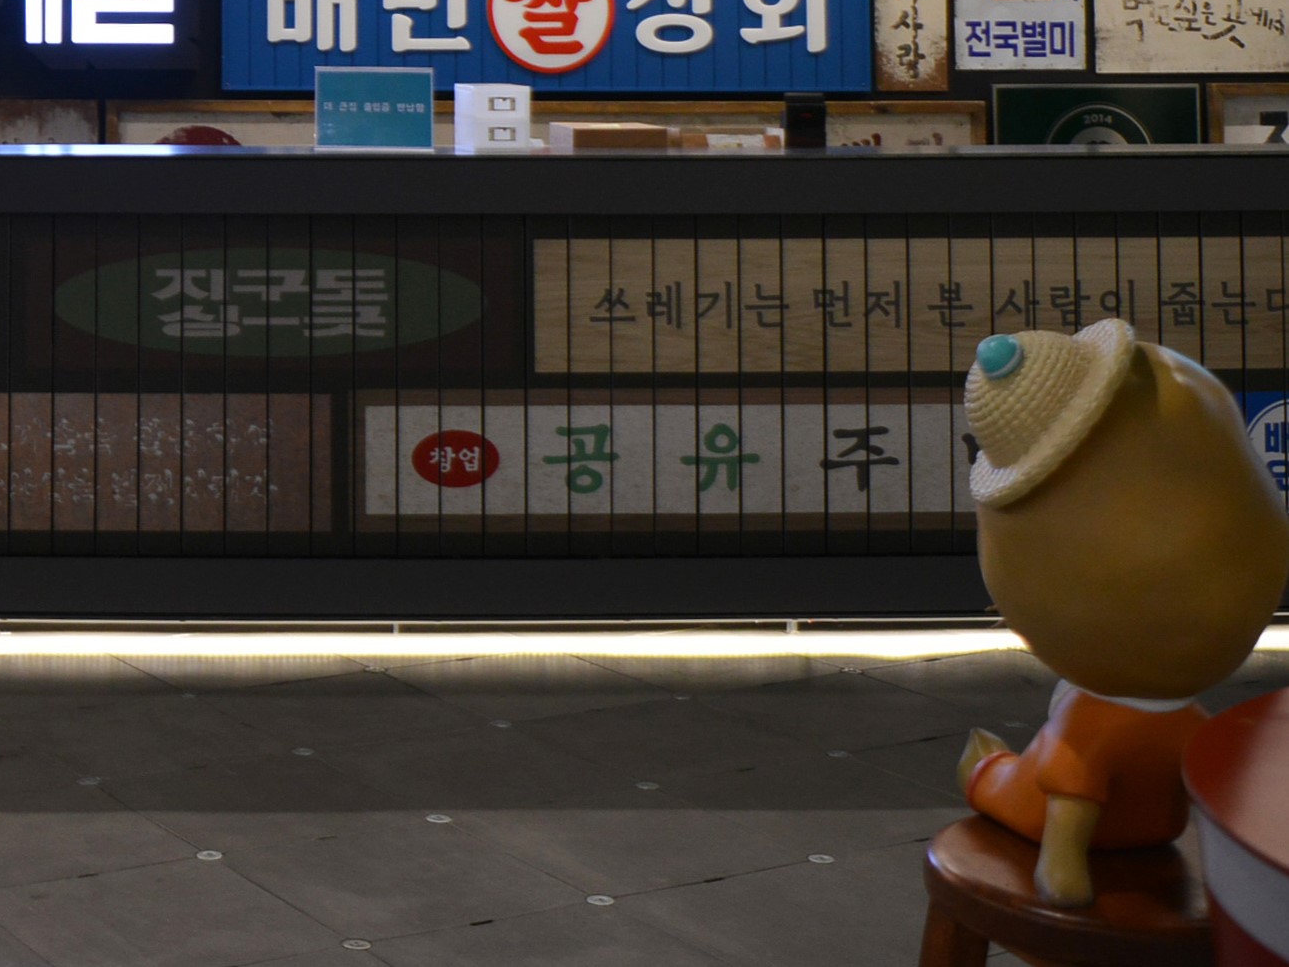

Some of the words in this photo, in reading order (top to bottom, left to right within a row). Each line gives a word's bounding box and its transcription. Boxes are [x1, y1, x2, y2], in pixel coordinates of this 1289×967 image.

[964, 20, 1076, 58] 전국별미
[589, 281, 789, 329] 쓰레기는
[812, 281, 901, 328] 먼저
[927, 282, 973, 327] 본
[996, 279, 1134, 327] 사람이
[429, 446, 480, 473] 창업
